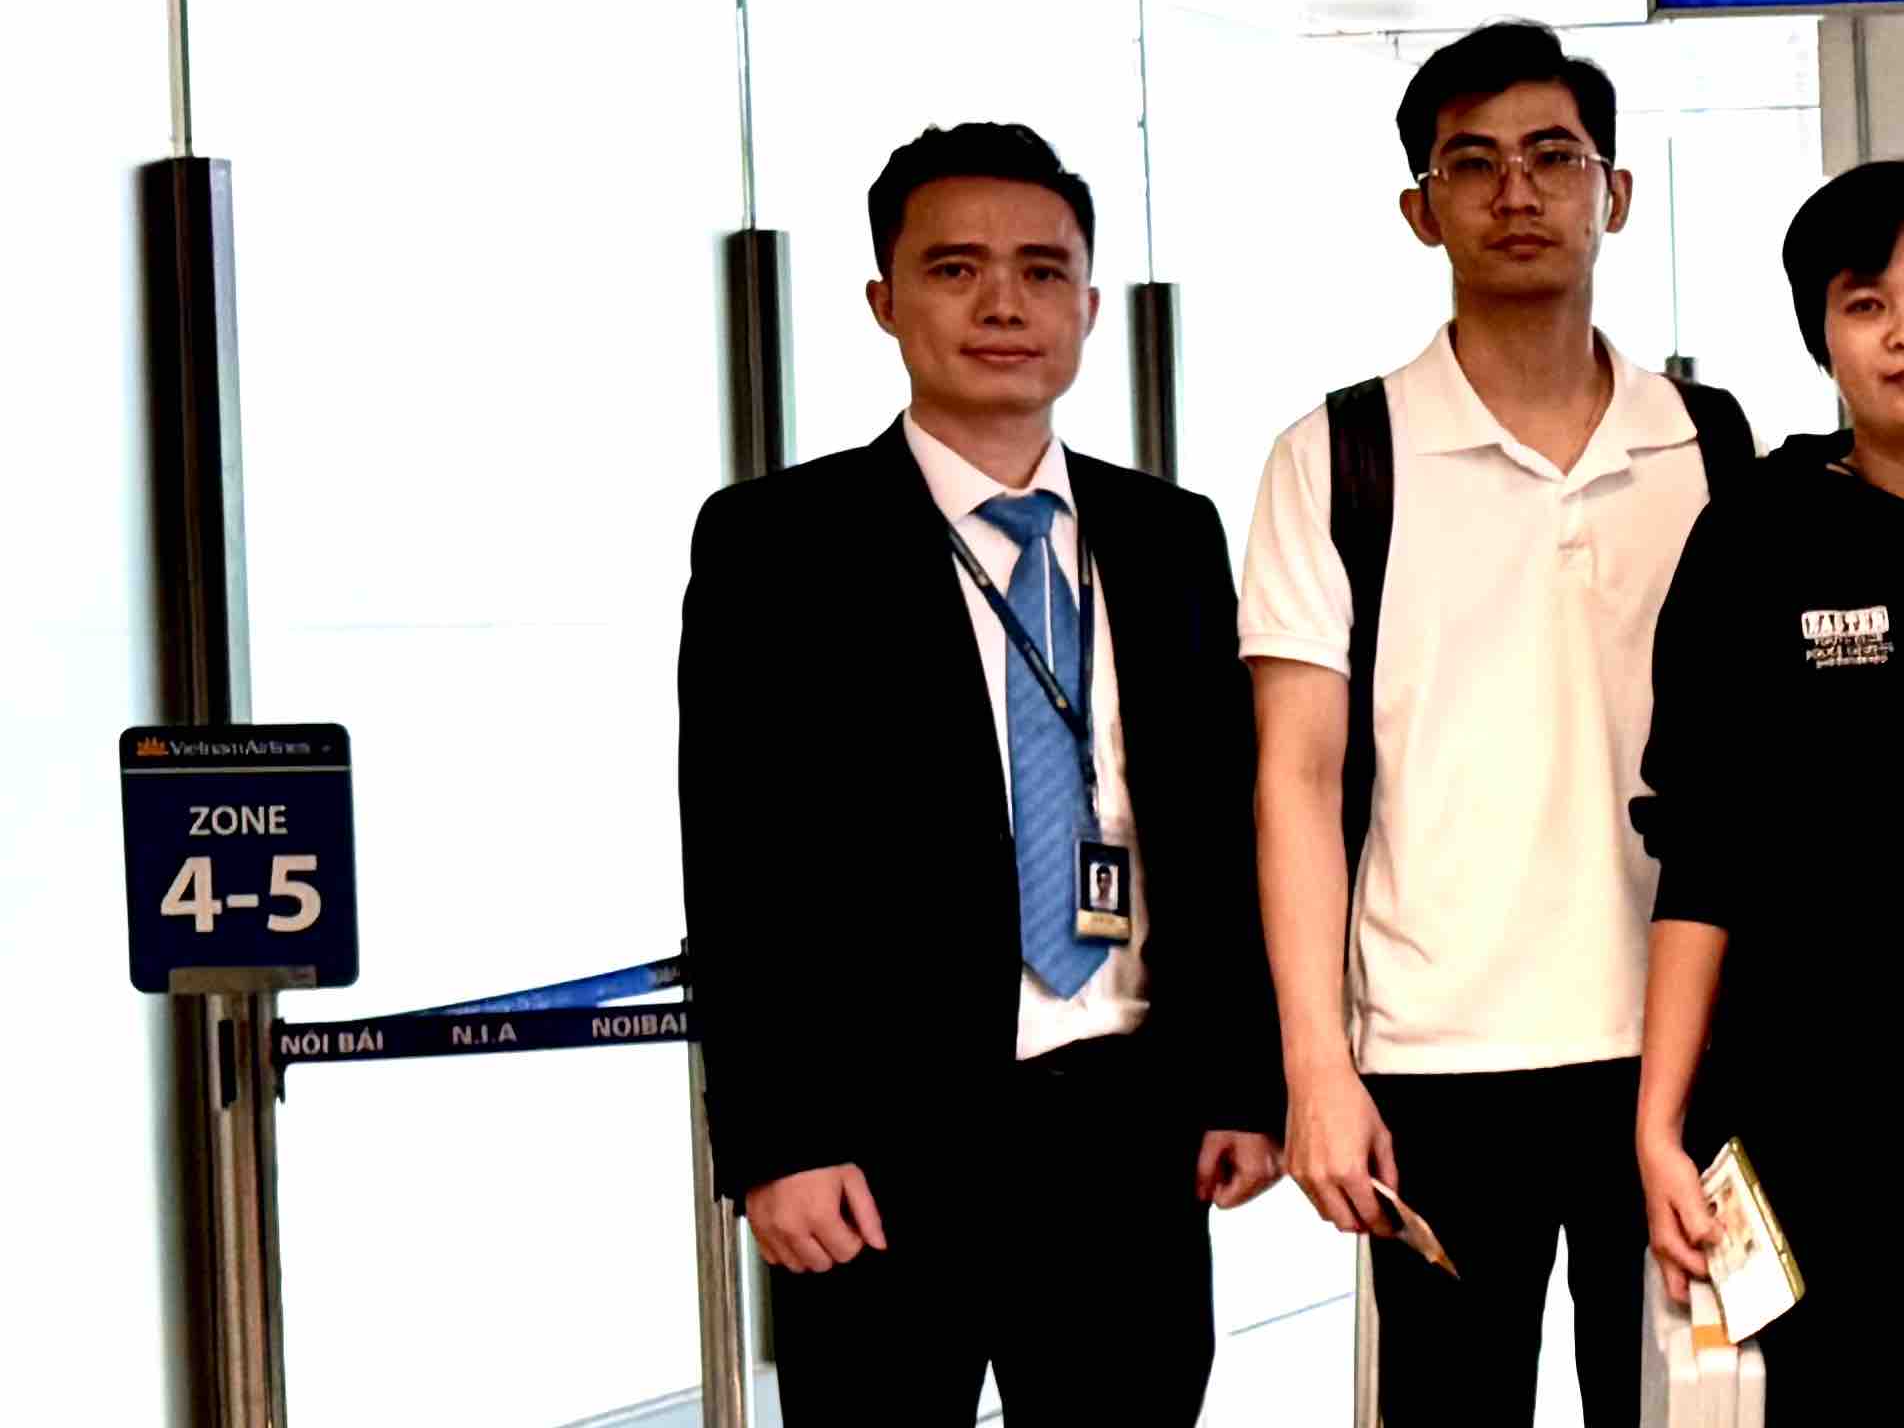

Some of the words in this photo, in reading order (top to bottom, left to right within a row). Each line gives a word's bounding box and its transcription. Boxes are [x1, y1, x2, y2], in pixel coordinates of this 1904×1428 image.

[189, 805, 288, 836] ZONE
[160, 854, 322, 933] 4-5
[452, 1021, 518, 1046] N.I.A
